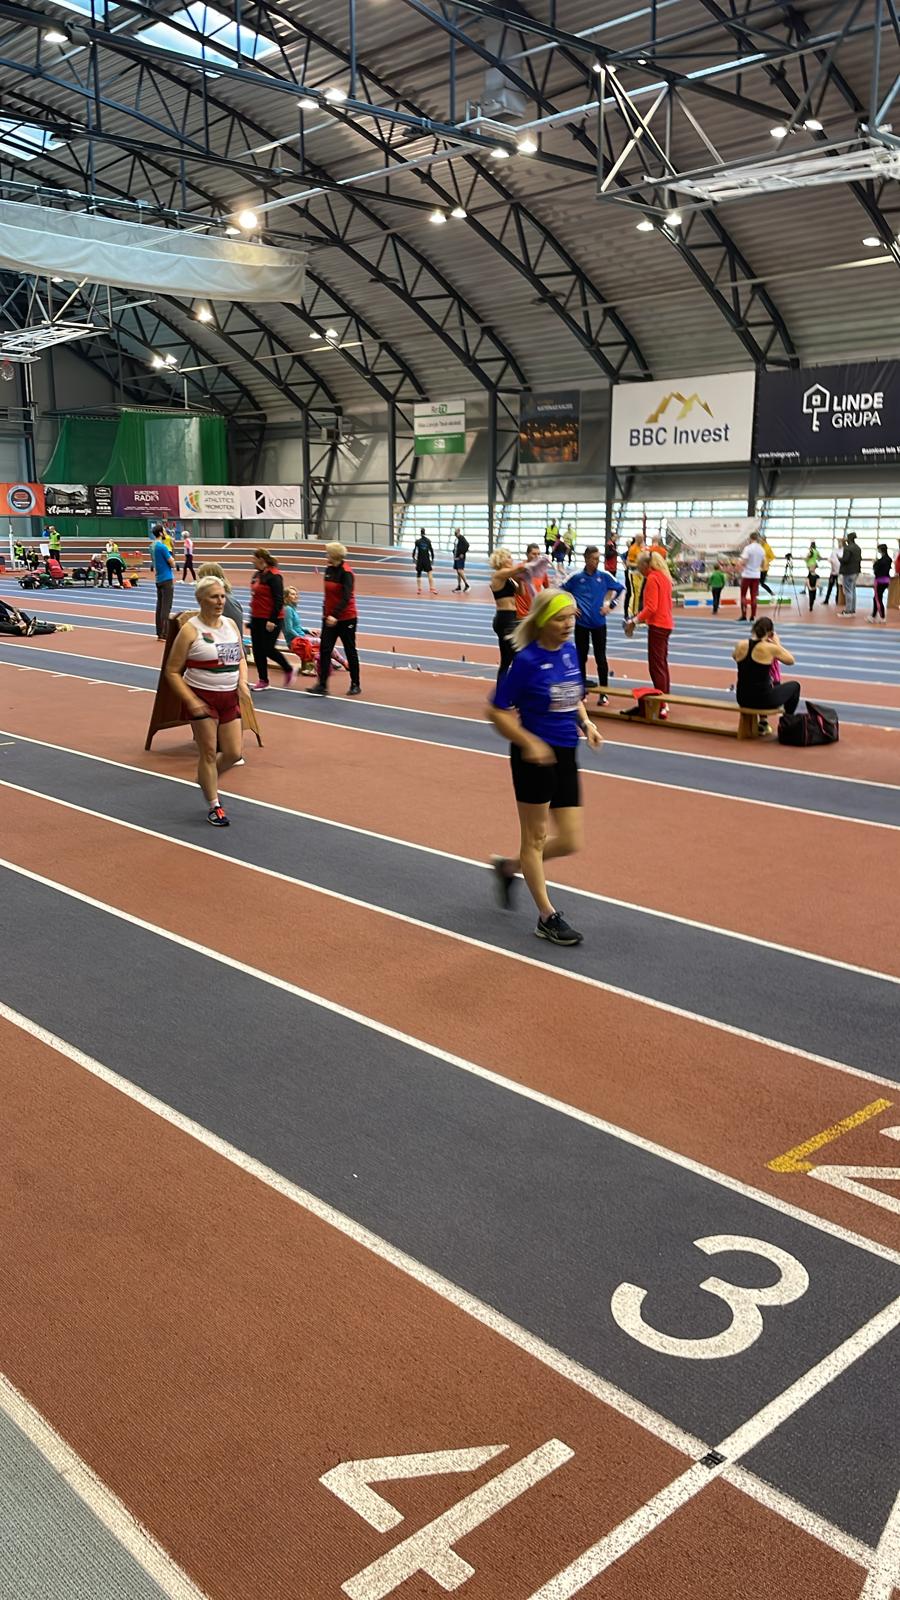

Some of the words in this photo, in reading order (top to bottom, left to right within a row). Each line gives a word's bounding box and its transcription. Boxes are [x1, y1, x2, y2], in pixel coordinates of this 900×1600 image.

[833, 392, 884, 412] LINDE
[831, 411, 881, 428] GRUPA
[629, 427, 668, 446] BBC
[673, 423, 730, 445] Invest
[268, 498, 296, 508] KORP
[611, 1234, 810, 1360] 3
[318, 1437, 576, 1600] 4
